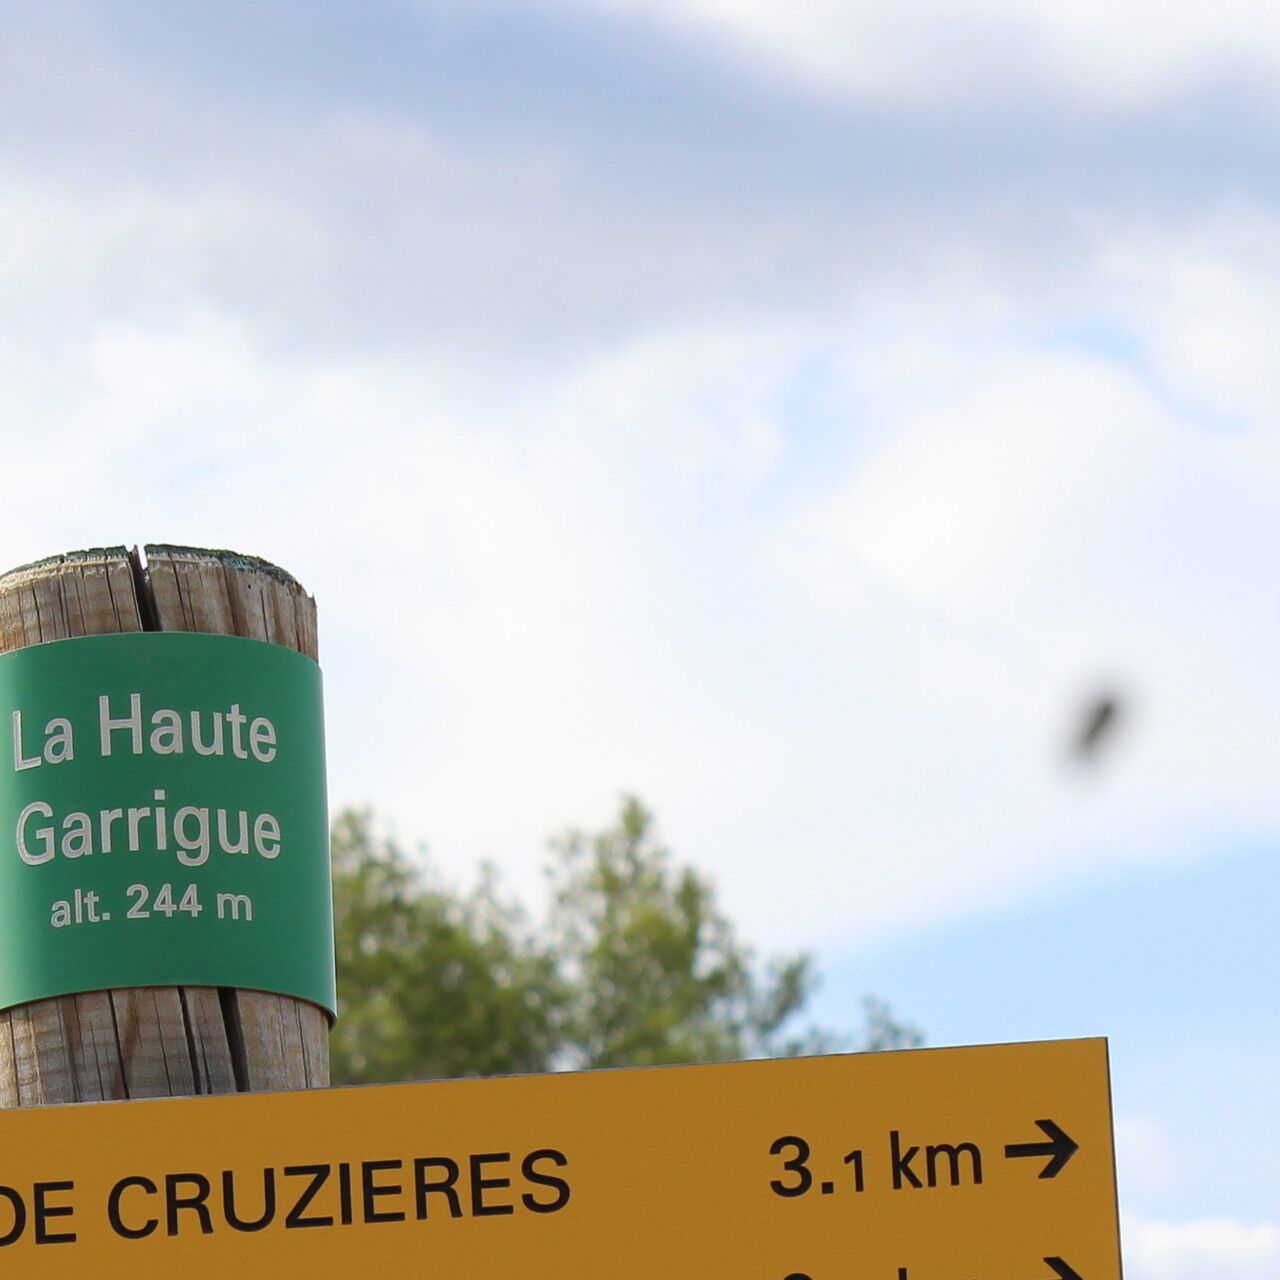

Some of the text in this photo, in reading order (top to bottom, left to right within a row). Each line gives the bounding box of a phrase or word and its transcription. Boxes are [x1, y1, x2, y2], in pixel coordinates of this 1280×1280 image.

[12, 694, 276, 771] La Haute
[16, 790, 280, 866] Garrigue
[52, 884, 251, 927] alt. 244 m
[108, 1149, 570, 1239] CRUZIERES
[770, 1131, 982, 1197] 3.1 km
